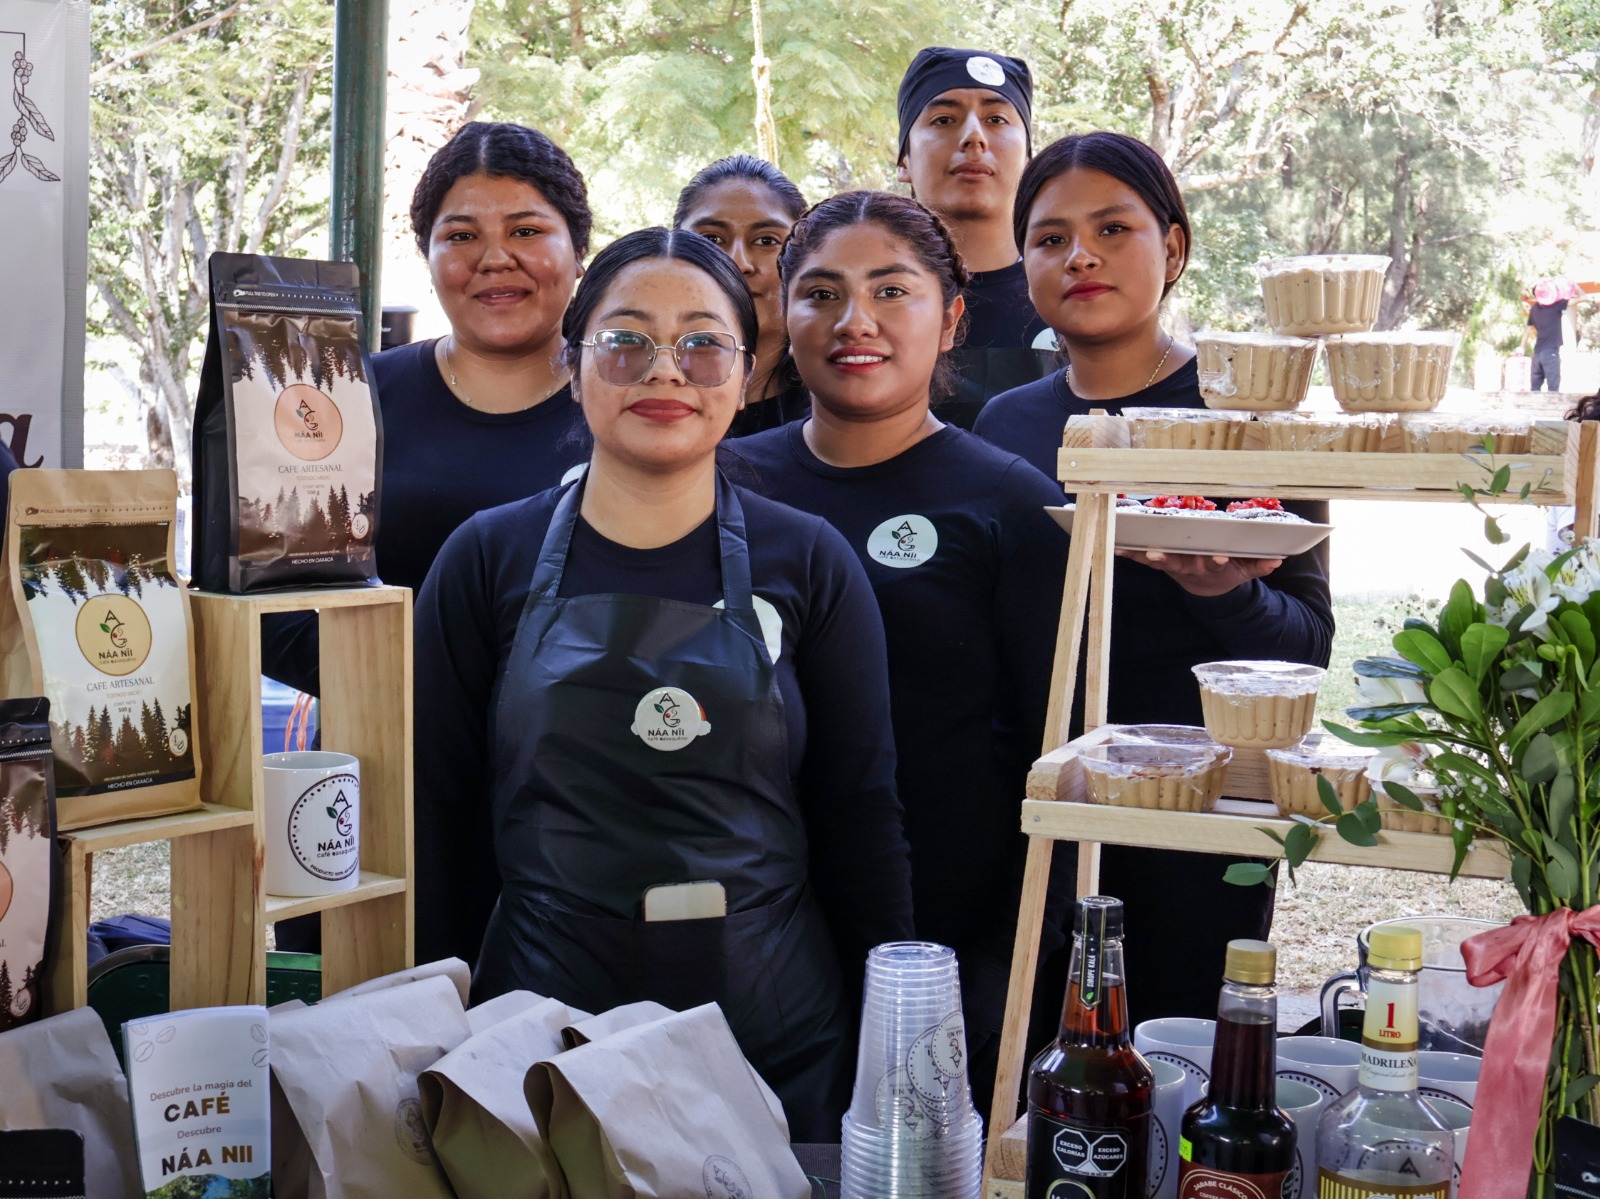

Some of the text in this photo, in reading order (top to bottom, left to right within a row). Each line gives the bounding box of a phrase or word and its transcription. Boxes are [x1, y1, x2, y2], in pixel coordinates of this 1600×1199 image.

[300, 464, 343, 473] ARTESANAL
[98, 649, 119, 660] NÁA
[109, 676, 155, 689] ARTESANAL
[648, 728, 668, 736] NÁA
[107, 781, 125, 789] HECHO
[132, 777, 153, 786] OAXACA
[318, 839, 342, 851] NÁA
[311, 864, 335, 877] PRODUCTO
[1086, 968, 1095, 988] SIROPE
[1386, 1003, 1395, 1028] 1
[1379, 1029, 1401, 1038] LITRO
[150, 1079, 252, 1101] Descubre la magia del
[164, 1092, 230, 1122] CAFÉ
[177, 1125, 222, 1139] Descubre
[1057, 1146, 1085, 1158] CALORÍAS
[1060, 1140, 1083, 1151] EXCESO
[161, 1145, 253, 1177] NÁA NII
[1193, 1180, 1248, 1199] JARABE CLÁSICO
